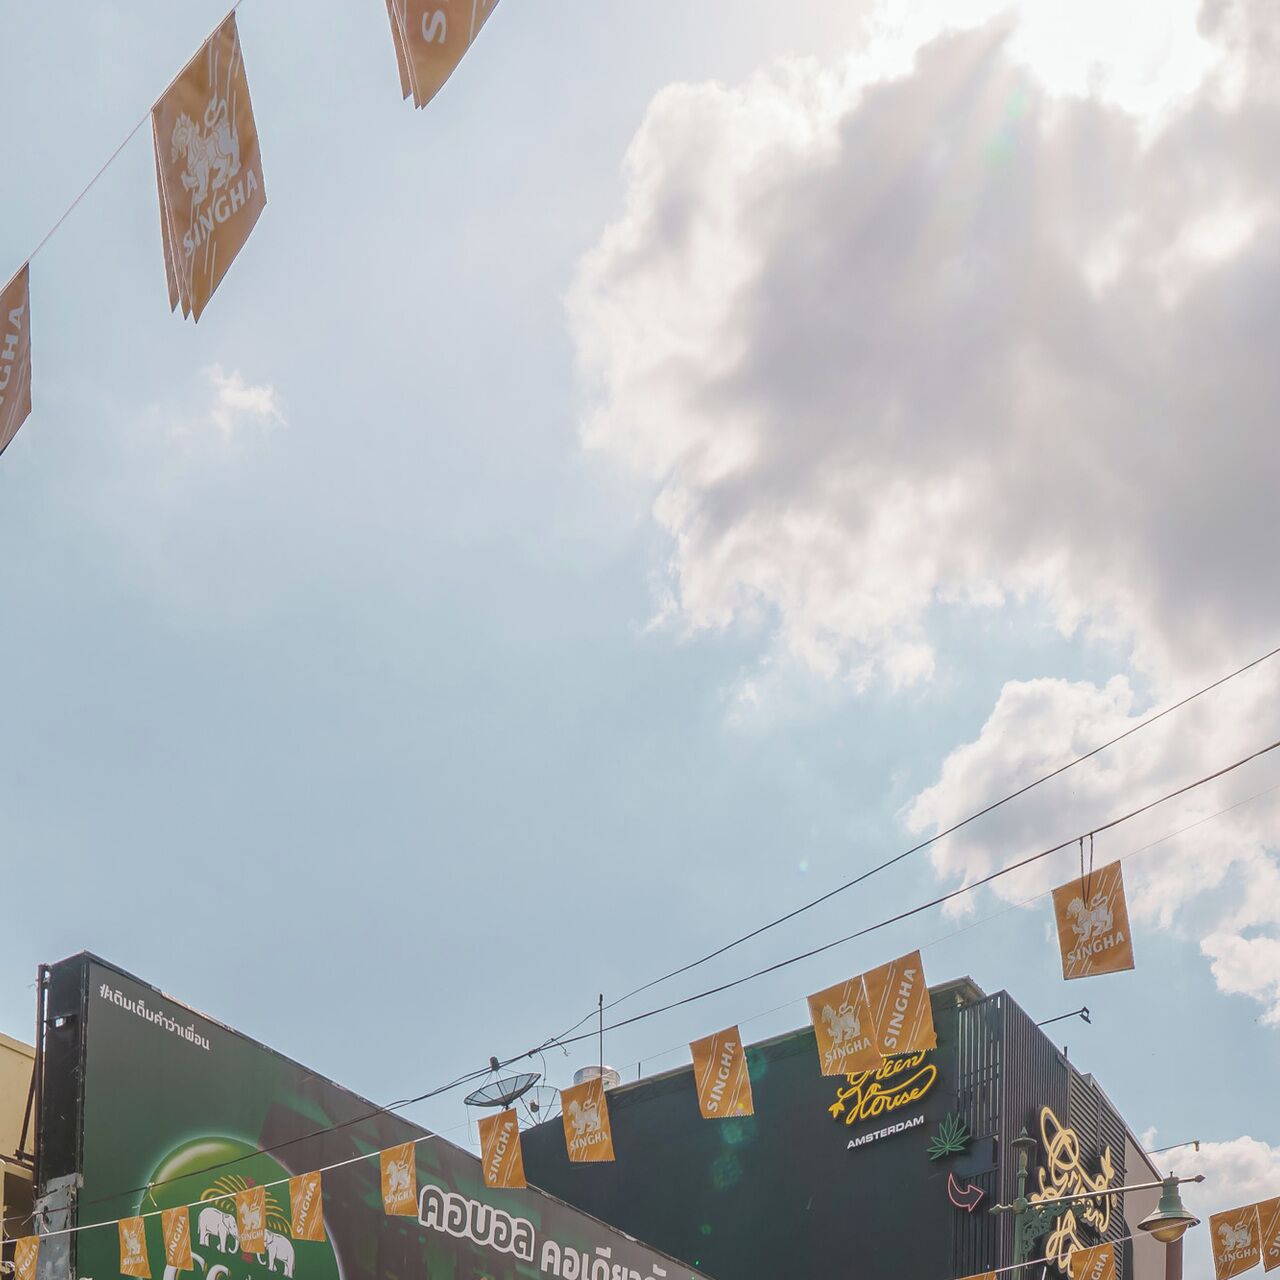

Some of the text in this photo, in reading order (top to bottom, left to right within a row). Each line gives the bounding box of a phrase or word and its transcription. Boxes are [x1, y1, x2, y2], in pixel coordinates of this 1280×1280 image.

[182, 168, 257, 258] SINGHA
[1067, 930, 1125, 965] SINGHA
[884, 967, 917, 1049] SINGHA
[707, 1041, 736, 1112] SINGHA
[824, 1036, 871, 1064] SINGHA
[837, 1064, 937, 1124] House
[489, 1121, 514, 1183] SINGHA
[570, 1131, 608, 1152] SINGHA
[847, 1115, 924, 1149] AMSTERDAM
[296, 1182, 317, 1236] SINGHA
[418, 1184, 535, 1262] คอบอล
[1218, 1248, 1258, 1264] SINGHA
